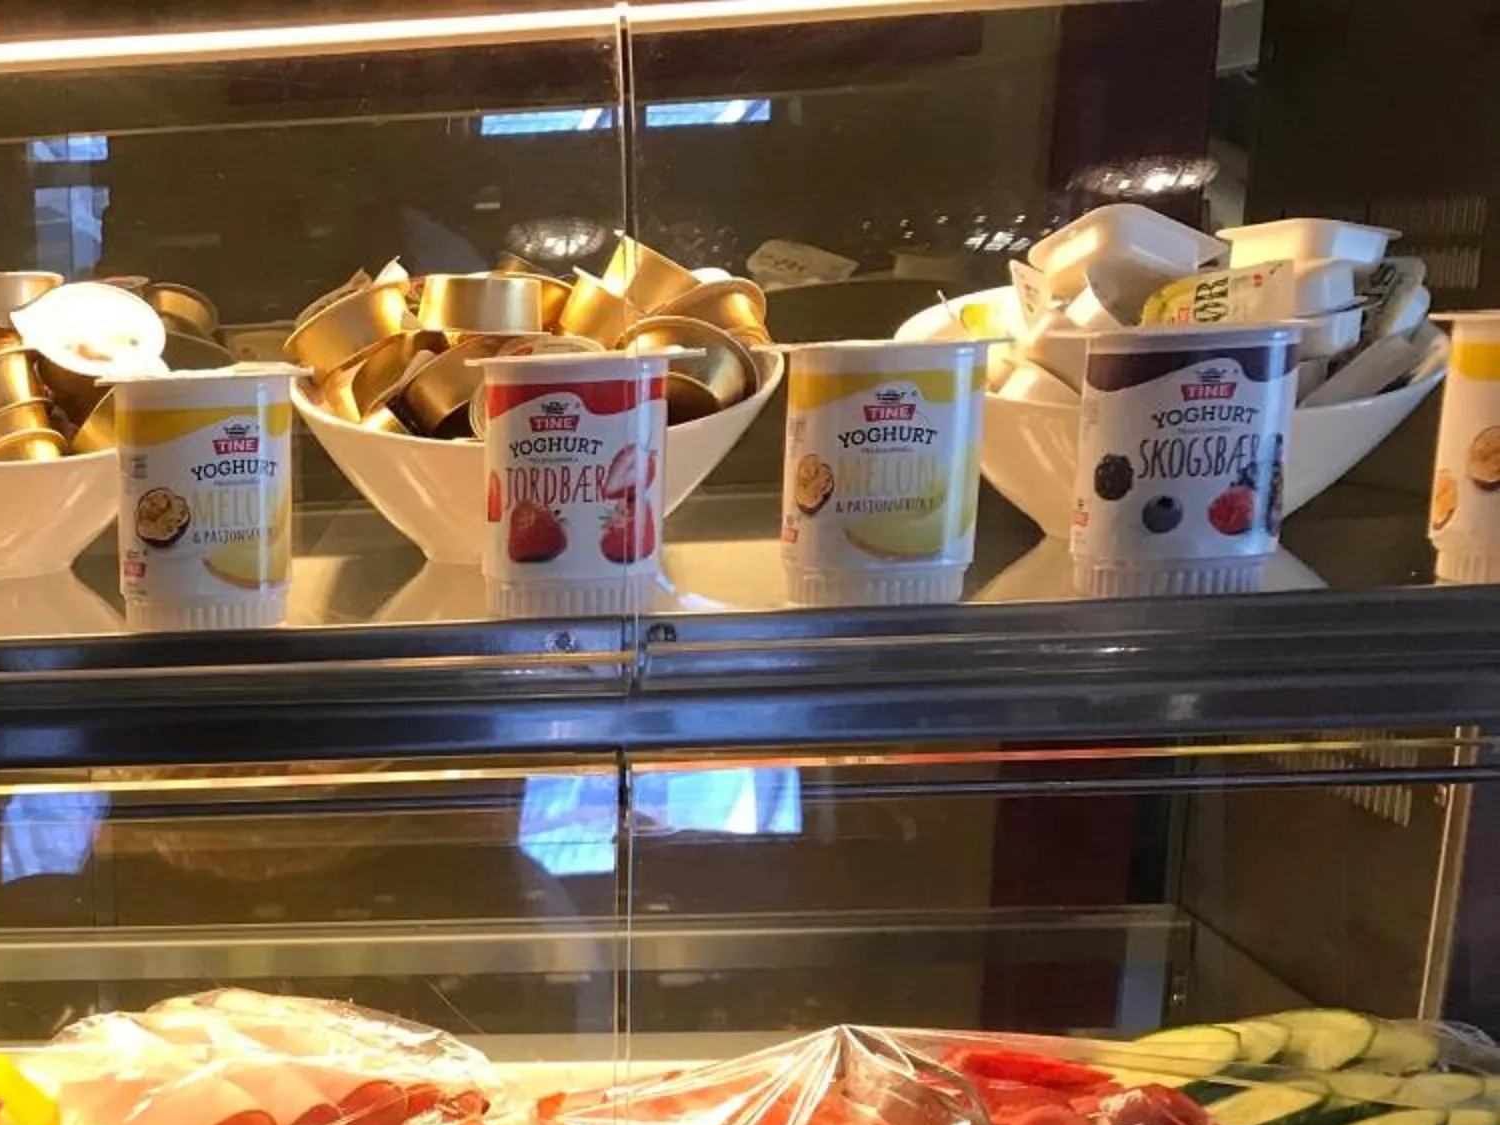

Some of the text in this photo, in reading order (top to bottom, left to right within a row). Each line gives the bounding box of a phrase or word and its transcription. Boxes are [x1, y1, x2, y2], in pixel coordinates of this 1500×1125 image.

[1185, 386, 1230, 400] TINE
[534, 417, 574, 430] TINE
[867, 407, 911, 421] TINE
[1152, 405, 1261, 429] YOGHURT
[217, 439, 257, 453] TINE
[509, 437, 603, 459] YOGHURT
[838, 426, 938, 449] YOGHURT
[191, 460, 278, 481] YOGHURT
[505, 464, 607, 510] JORDBÆR
